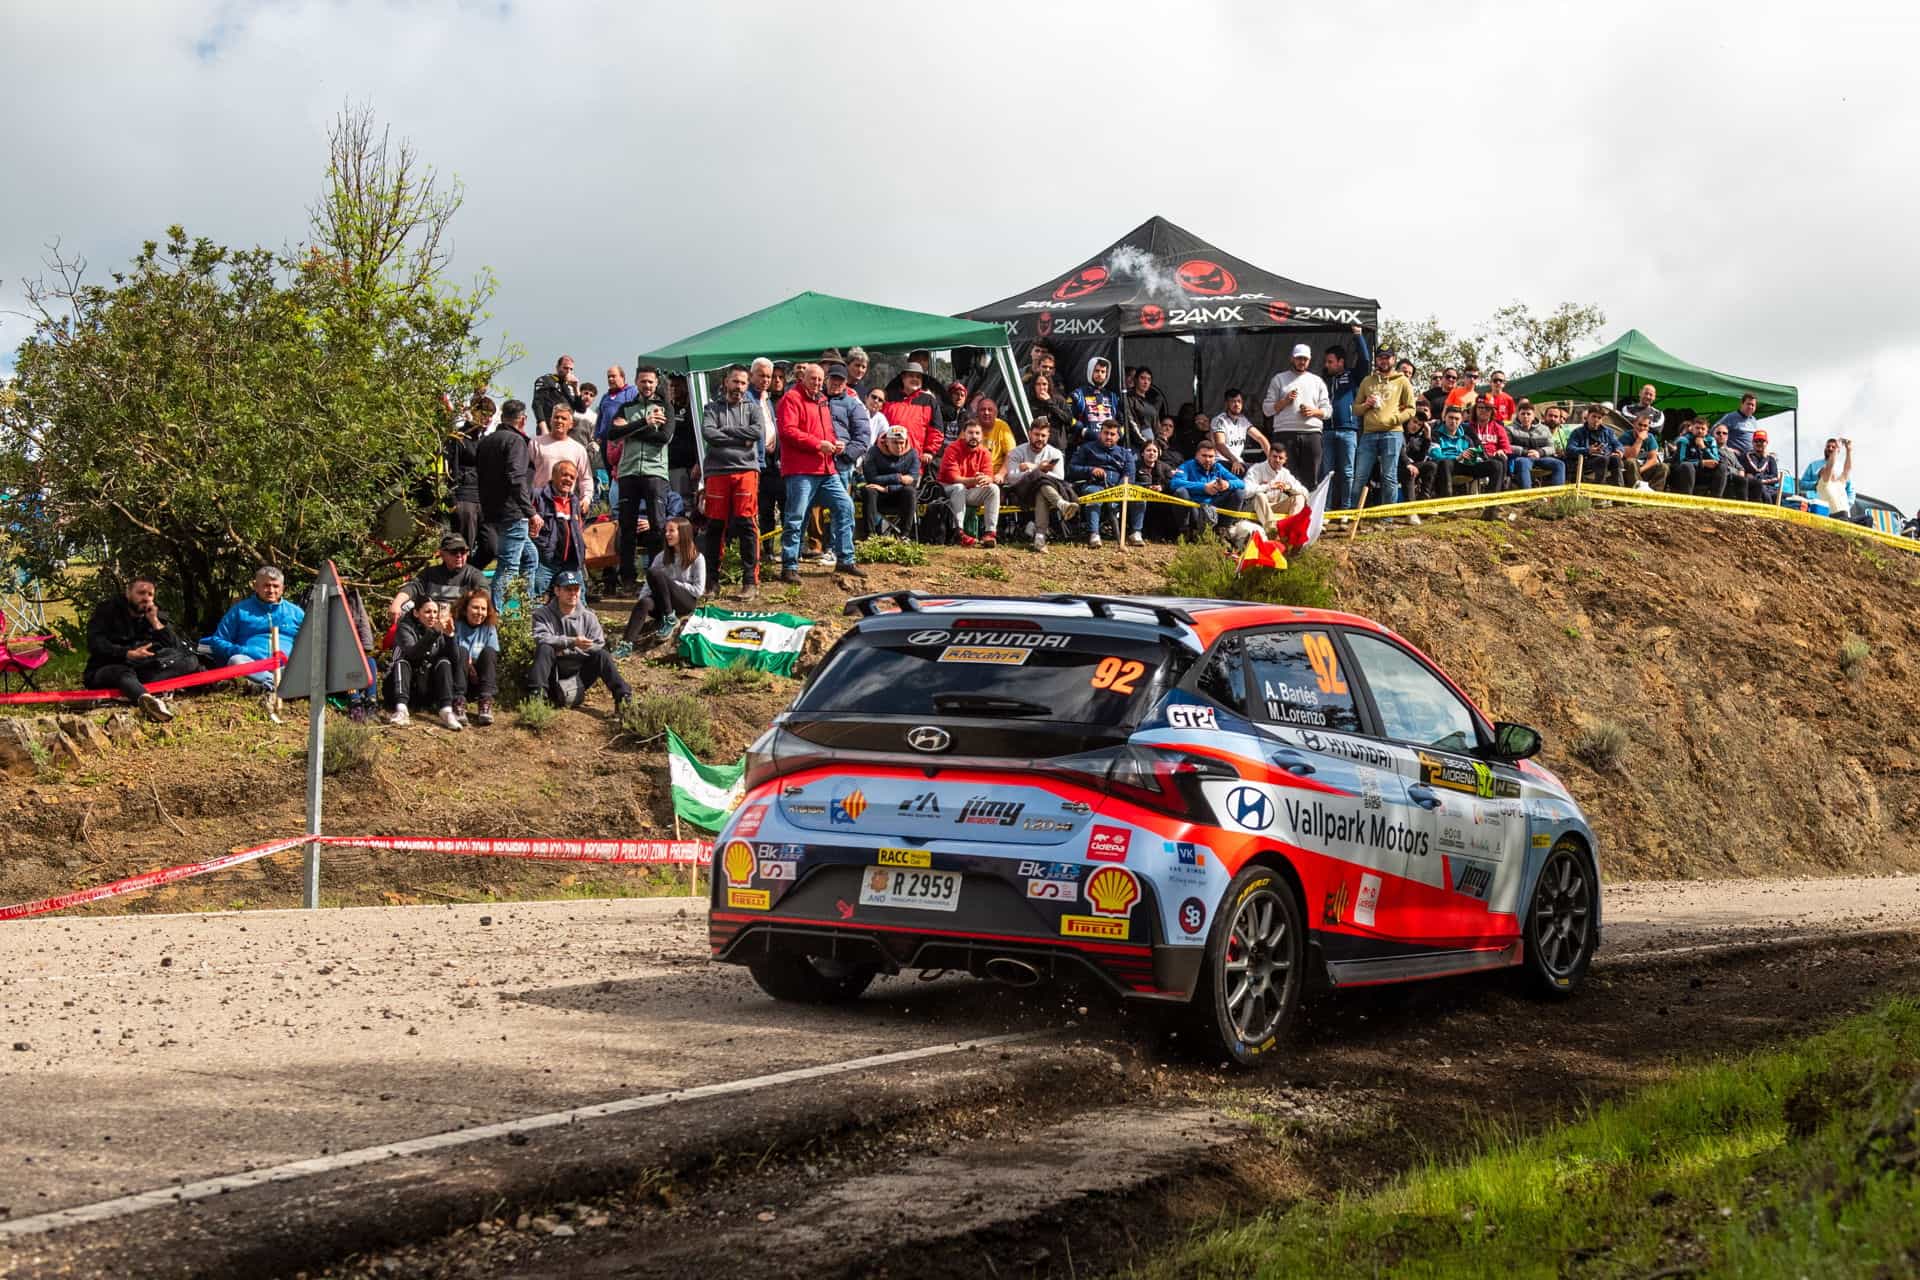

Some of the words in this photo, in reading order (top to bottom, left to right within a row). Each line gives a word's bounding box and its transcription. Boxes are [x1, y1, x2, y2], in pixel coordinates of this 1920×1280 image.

[1169, 305, 1244, 326] 24MX
[1294, 307, 1362, 324] 24MX
[1053, 318, 1106, 335] 24MX
[952, 631, 1072, 648] HYUNDAI
[1303, 633, 1347, 696] 92
[1091, 657, 1145, 694] 92
[1265, 680, 1277, 699] A.
[1279, 683, 1319, 705] Bartés
[1325, 736, 1392, 769] HYUNDAI
[1441, 767, 1476, 785] MORENA
[1285, 798, 1366, 846] Vallpark
[1370, 810, 1430, 857] Motors
[880, 849, 909, 864] RACC
[1179, 848, 1194, 859] VK
[1017, 860, 1047, 877] Bk
[892, 872, 905, 896] R
[908, 873, 954, 900] 2959
[868, 894, 887, 904] AND
[1067, 919, 1124, 936] PIRELLI
